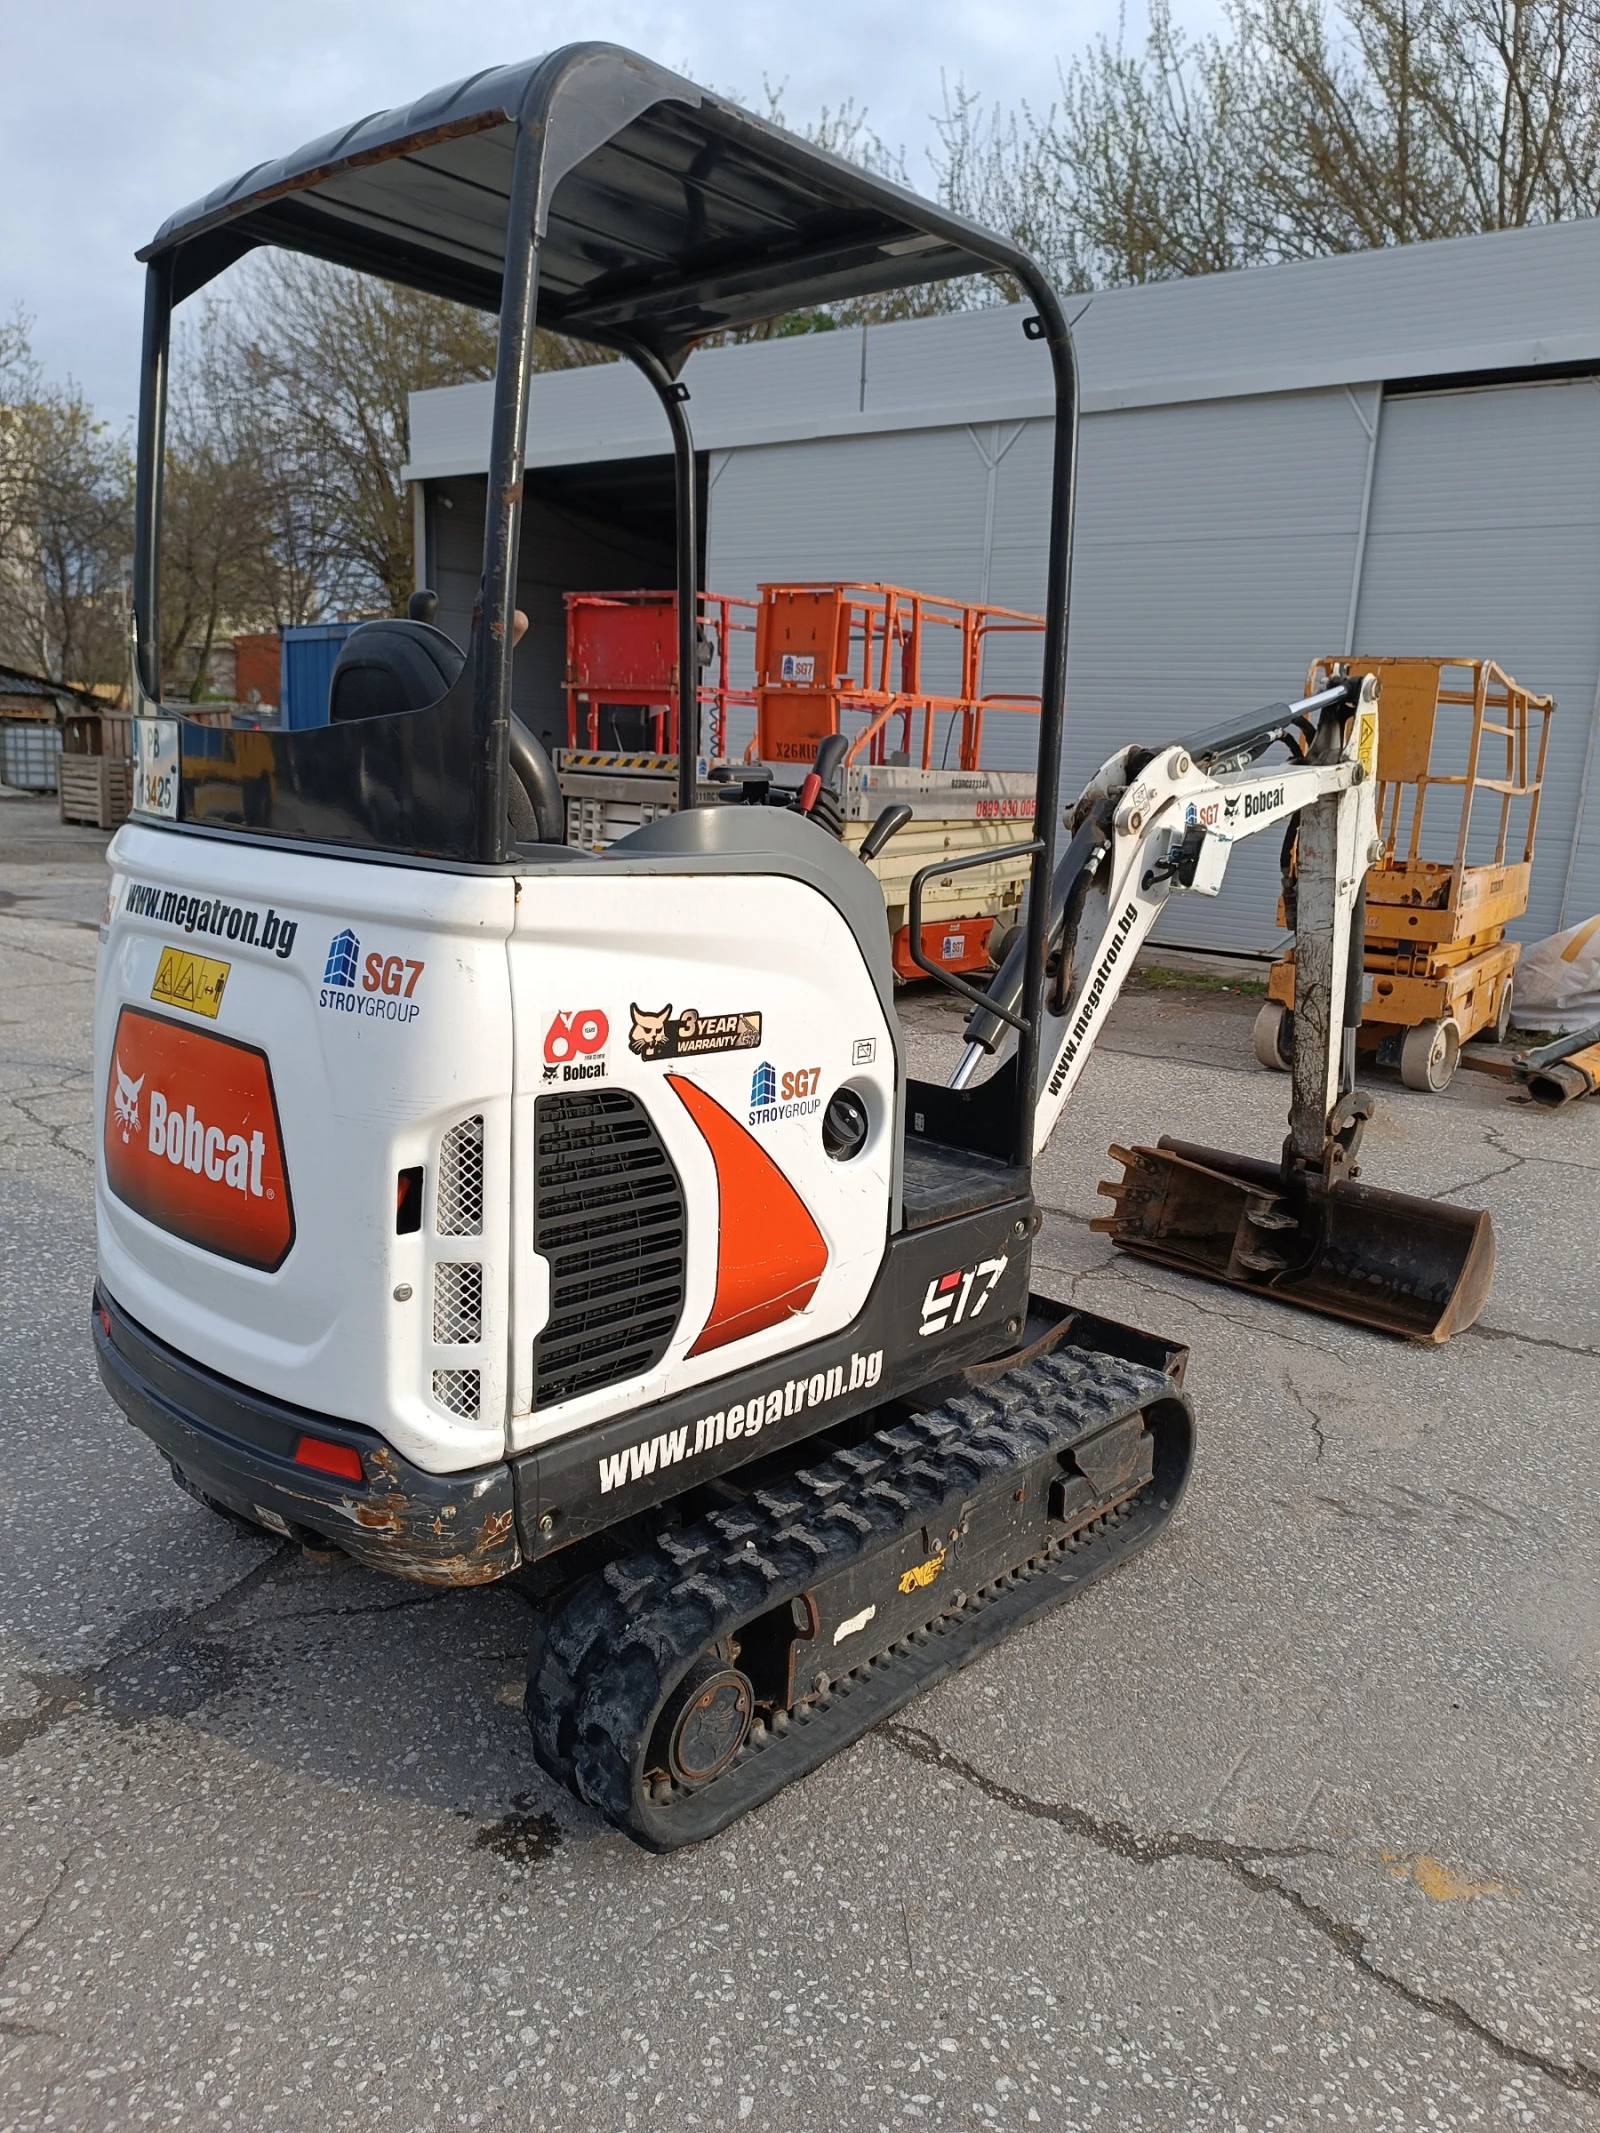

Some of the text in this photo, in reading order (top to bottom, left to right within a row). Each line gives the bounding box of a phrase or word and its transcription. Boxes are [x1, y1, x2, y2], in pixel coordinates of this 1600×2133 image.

[795, 662, 813, 675] SG7
[139, 773, 171, 809] 13425
[1244, 782, 1285, 818] Bobcat
[976, 800, 999, 817] 0899
[1001, 800, 1018, 817] 930
[1200, 803, 1219, 826] SG7
[125, 883, 299, 959] www.megatron.bg
[952, 942, 963, 953] SG7
[362, 952, 425, 999] SG7
[319, 989, 420, 1023] STROYGROUP
[1048, 902, 1139, 1097] www.megatron.bg
[543, 1009, 610, 1064] 60
[678, 1009, 738, 1038] 3 YEAR
[677, 1035, 738, 1053] WARRANTY
[563, 1062, 606, 1082] Bobcat
[781, 1067, 821, 1101] SG7
[748, 1099, 821, 1126] STROYGROUP
[148, 1090, 266, 1197] Bobcat
[919, 1255, 1008, 1336] E17
[598, 1350, 884, 1494] www.megatron.bg
